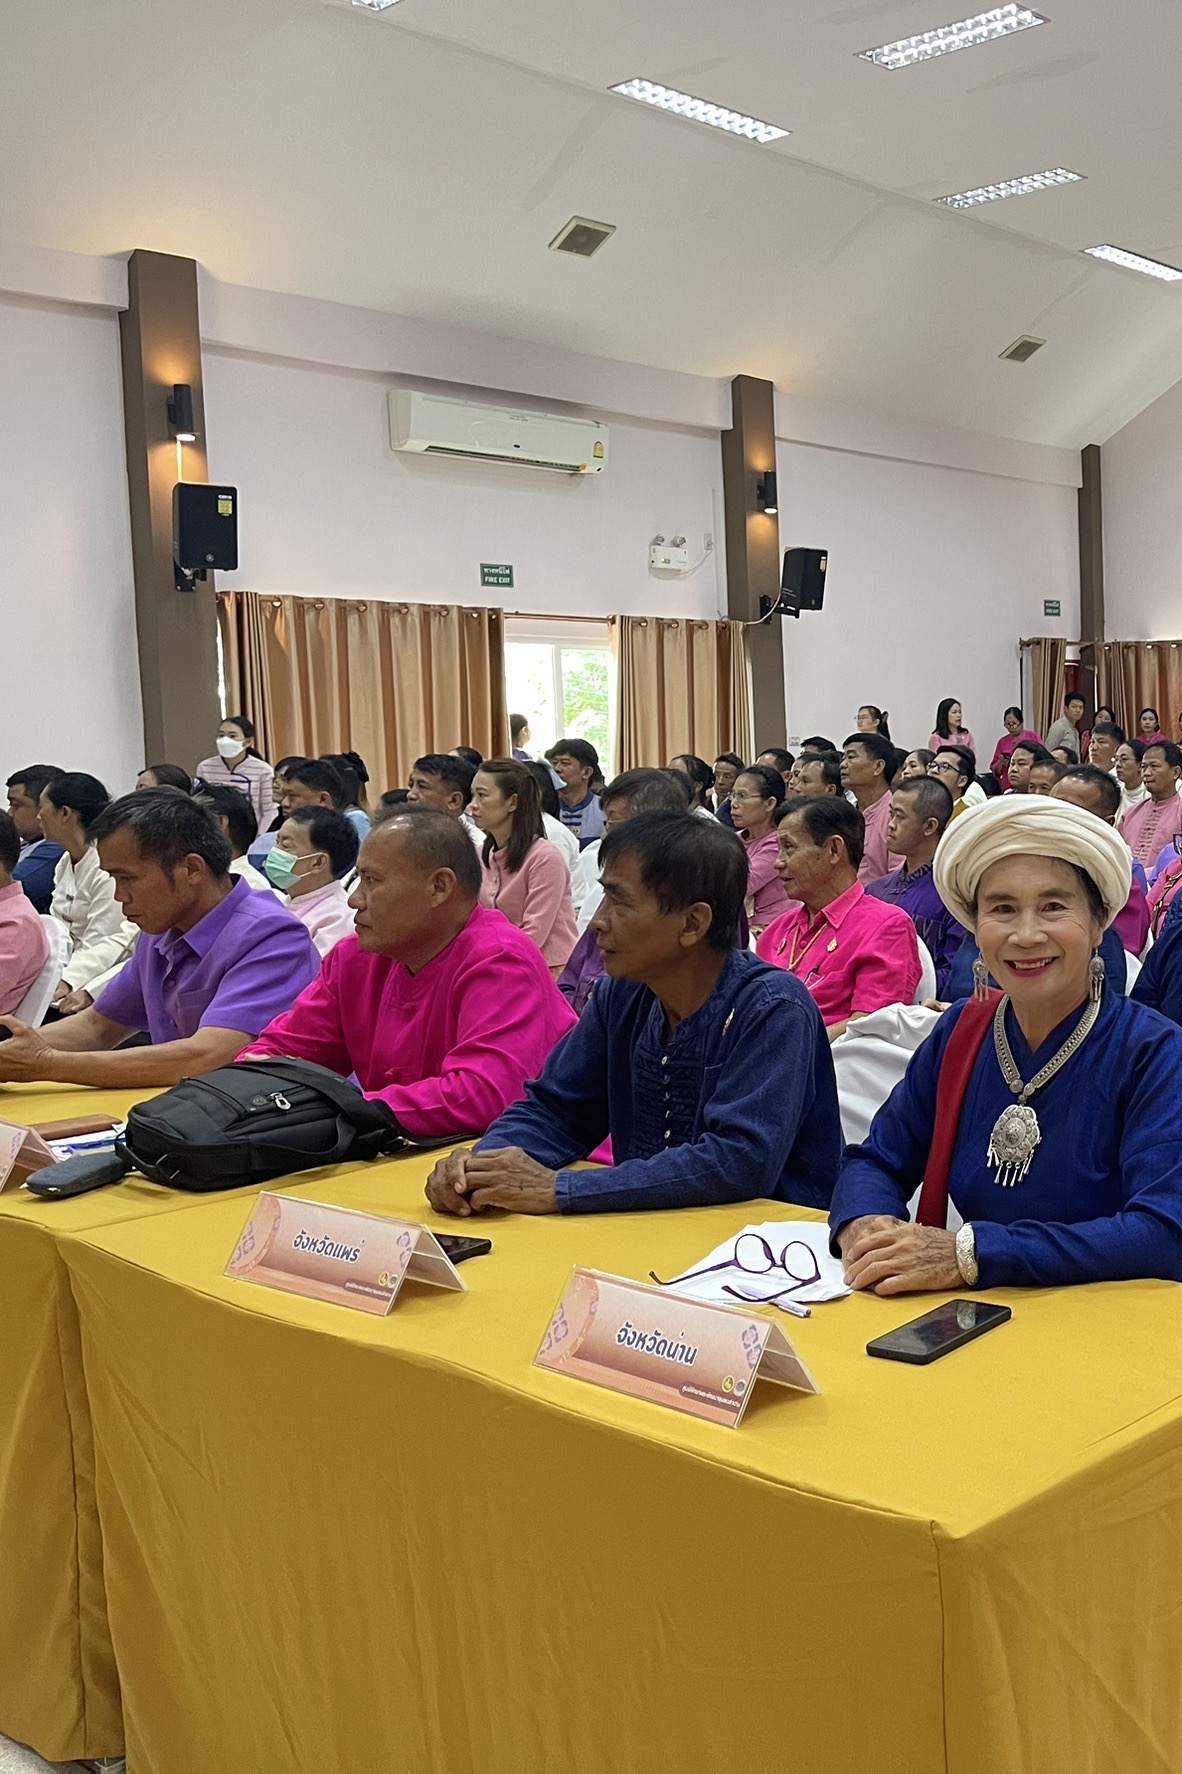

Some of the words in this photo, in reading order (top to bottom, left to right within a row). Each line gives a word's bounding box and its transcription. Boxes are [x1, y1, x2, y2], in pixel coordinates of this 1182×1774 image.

[293, 1229, 365, 1262] จังหวัดแพร่
[617, 1321, 698, 1365] จังหวัดน่าน
